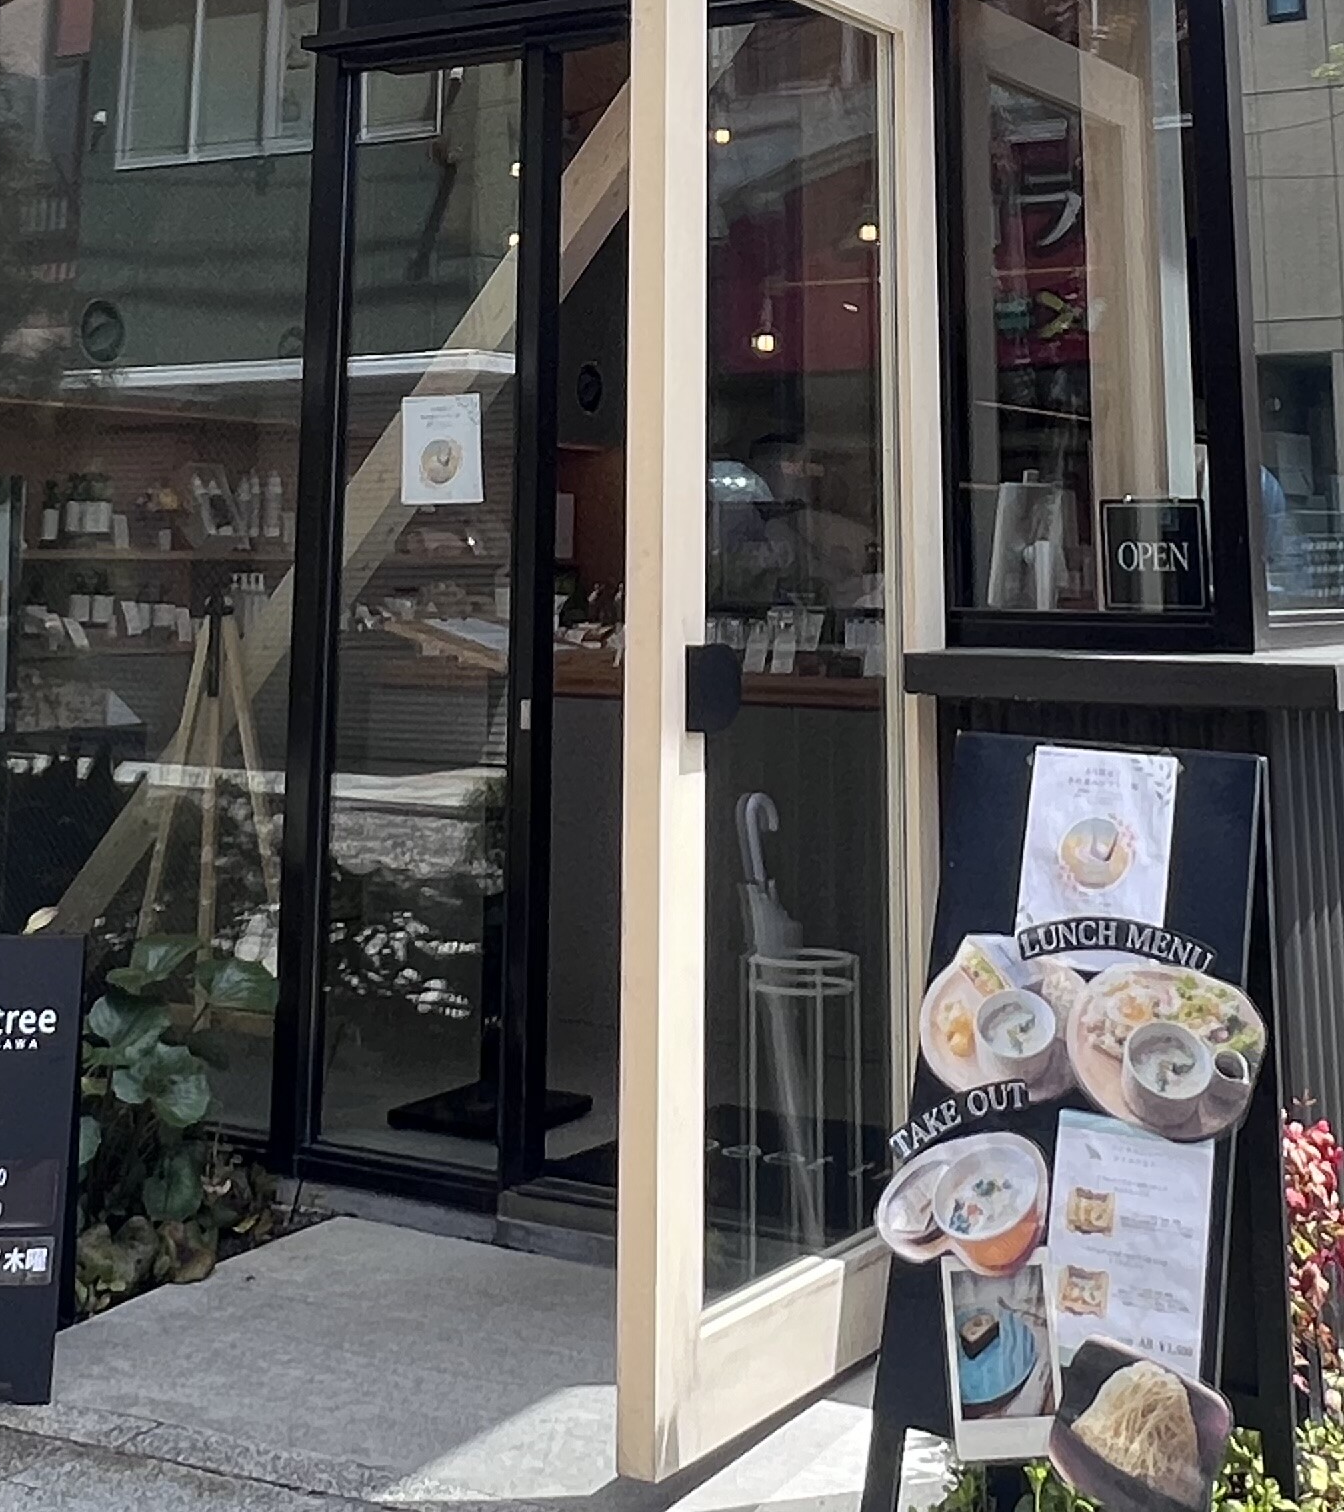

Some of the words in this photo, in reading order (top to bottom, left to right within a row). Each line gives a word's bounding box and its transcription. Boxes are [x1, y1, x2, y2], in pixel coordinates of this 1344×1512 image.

[1117, 541, 1189, 572] OPEN
[1020, 920, 1117, 957] LUNCH
[1126, 923, 1214, 972] MENU
[888, 1099, 962, 1158] TAKE
[967, 1082, 1027, 1117] OUT
